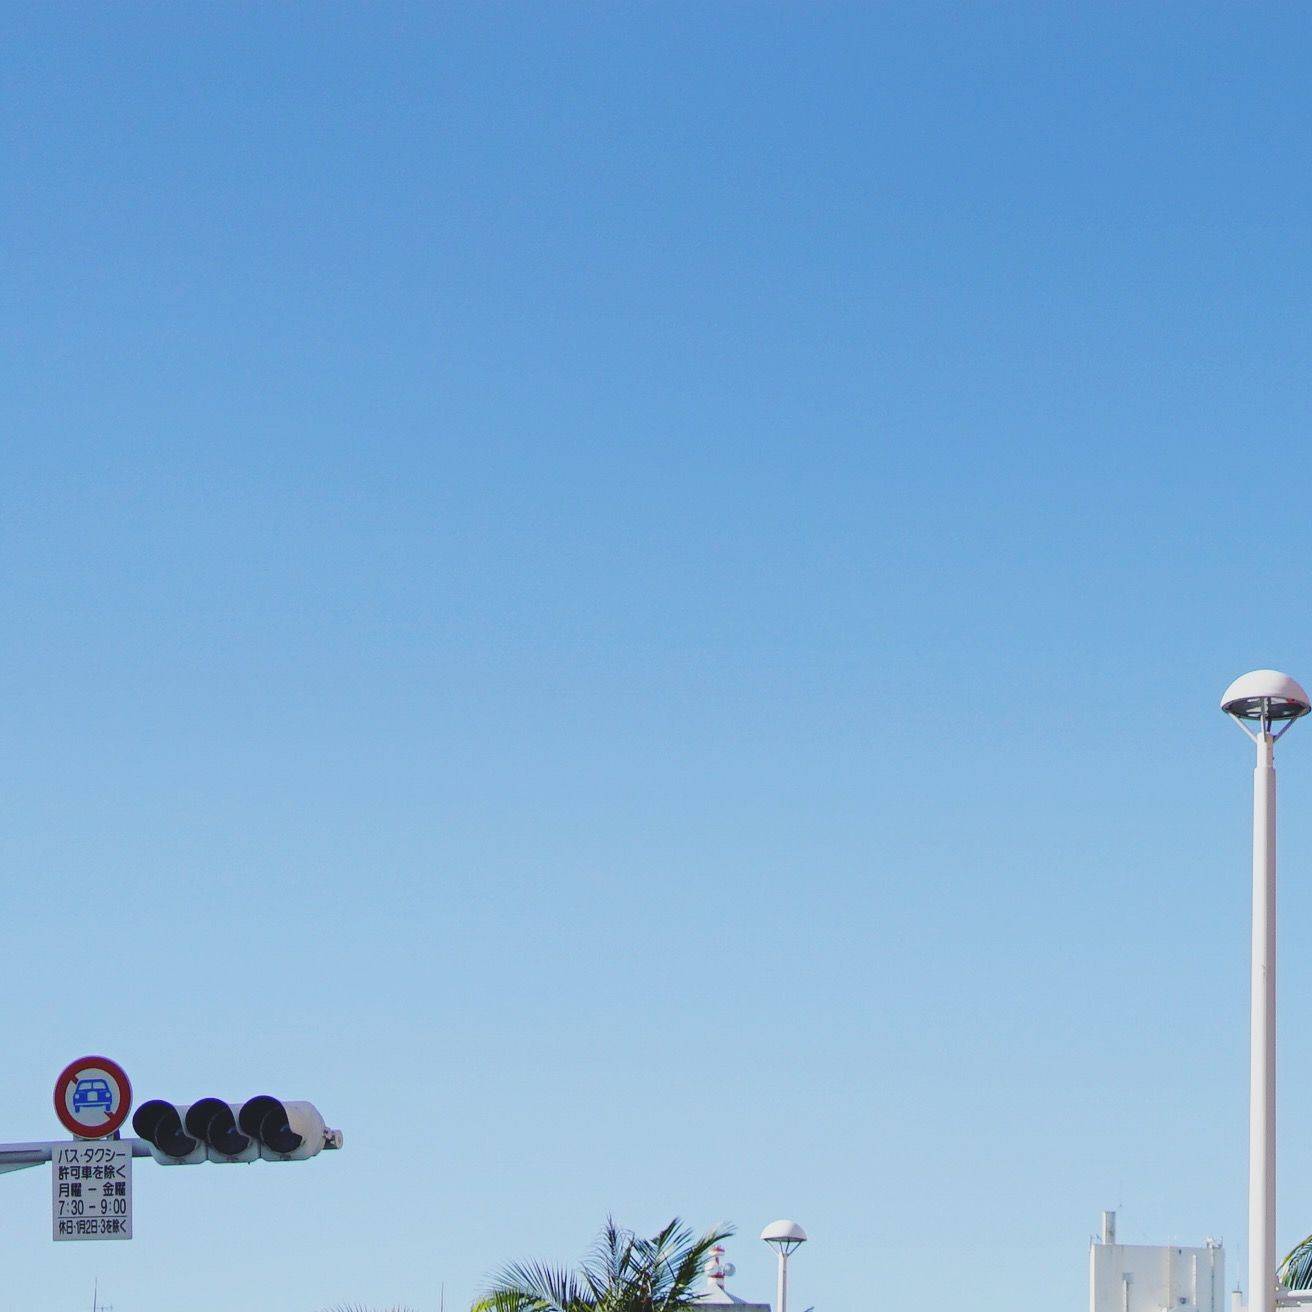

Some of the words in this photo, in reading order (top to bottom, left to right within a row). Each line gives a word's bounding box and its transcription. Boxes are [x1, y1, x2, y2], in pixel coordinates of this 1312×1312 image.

[58, 1148, 126, 1163] バス・タクシー
[58, 1164, 126, 1180] 許可車を除く
[58, 1200, 84, 1216] 7:30
[100, 1199, 127, 1215] 9:00
